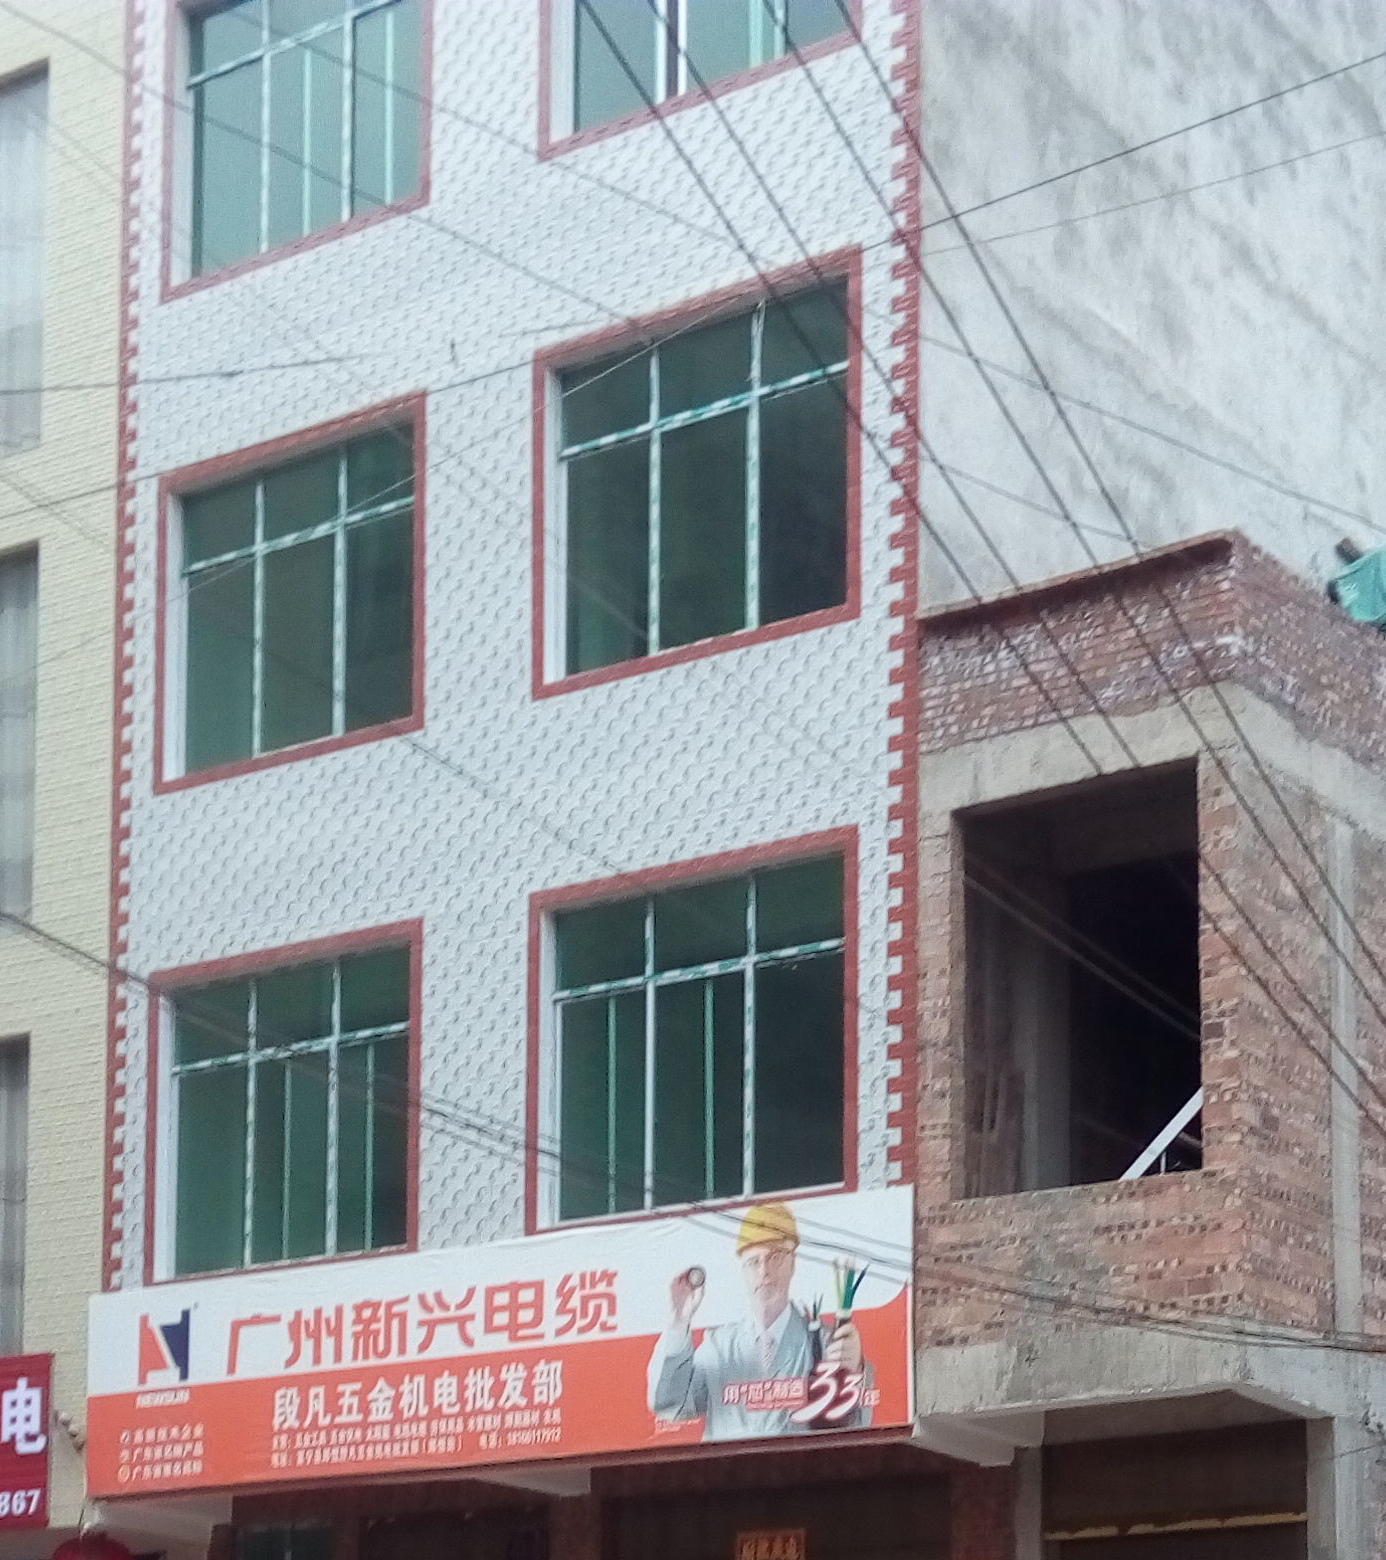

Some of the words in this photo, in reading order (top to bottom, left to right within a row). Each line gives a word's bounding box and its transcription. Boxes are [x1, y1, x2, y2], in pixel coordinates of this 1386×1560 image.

[227, 1270, 618, 1376] 广州新兴电缆
[271, 1358, 565, 1431] 段凡五金机电批发部
